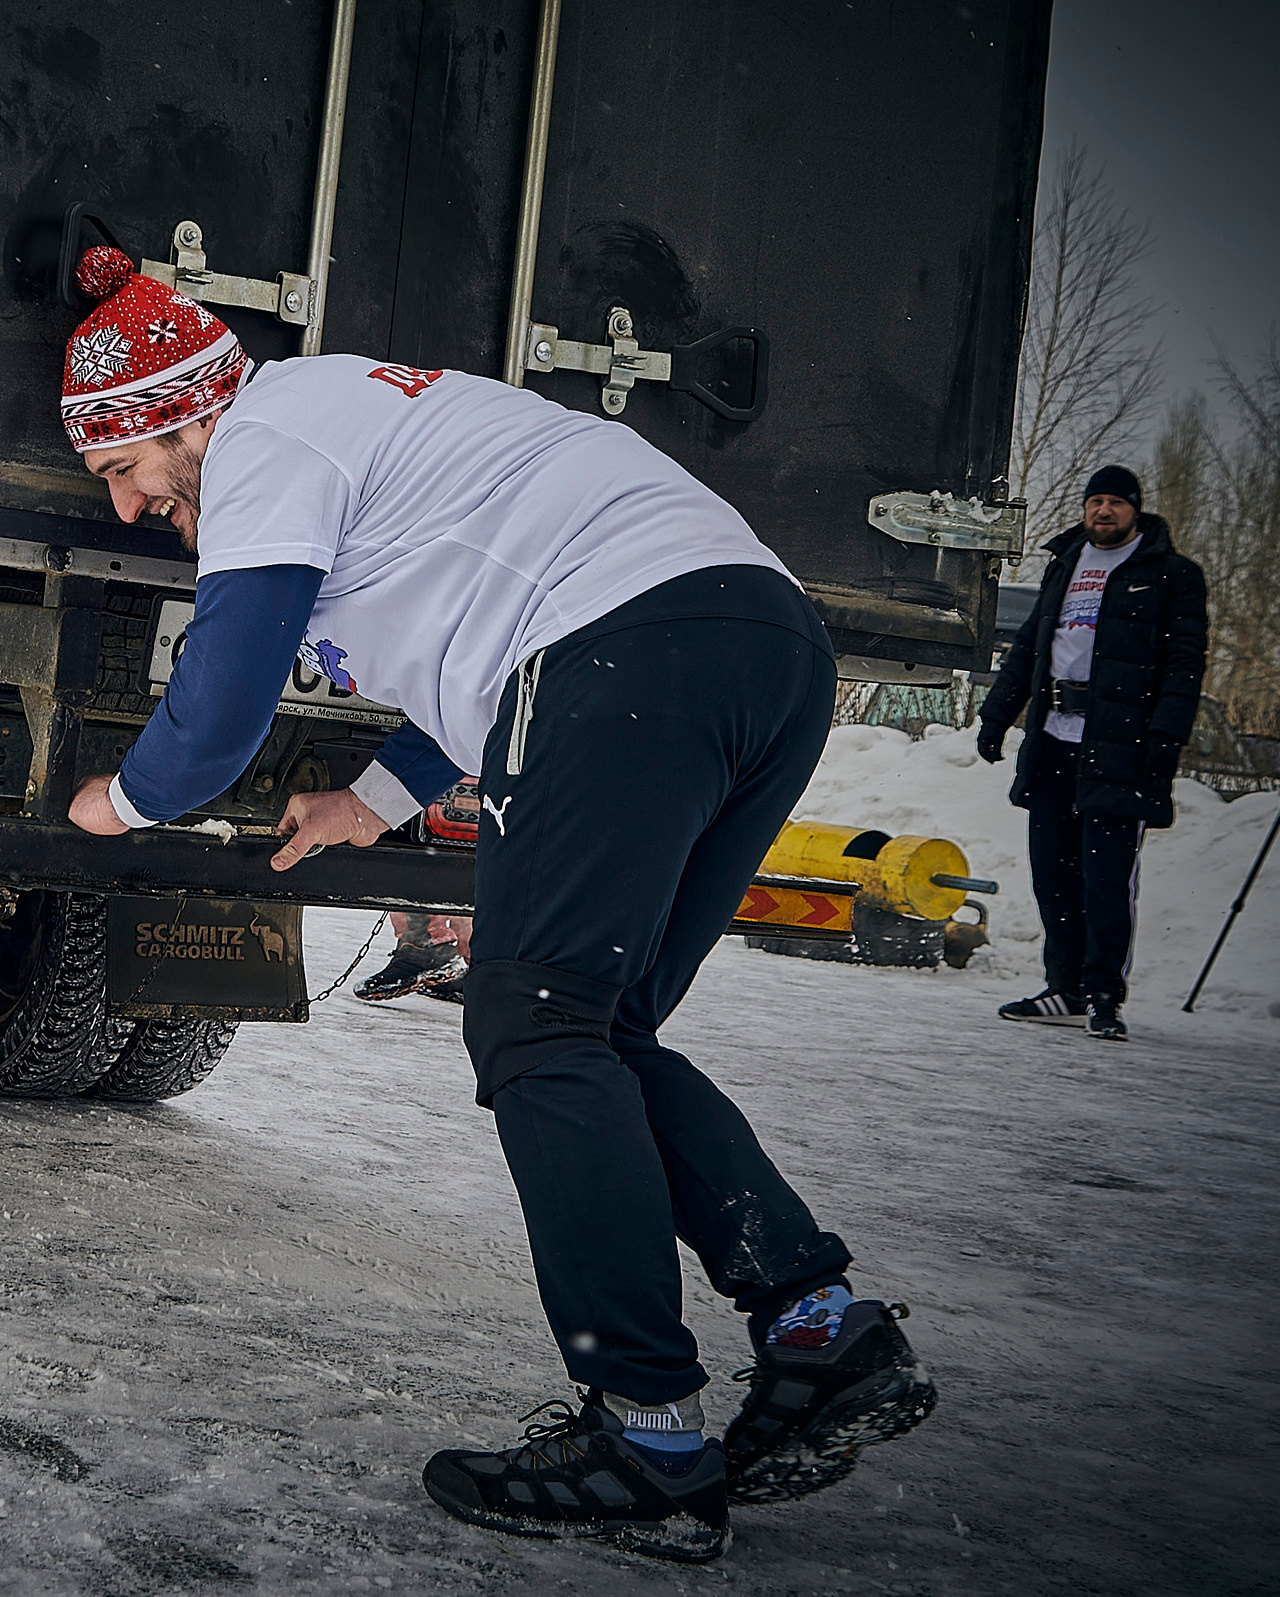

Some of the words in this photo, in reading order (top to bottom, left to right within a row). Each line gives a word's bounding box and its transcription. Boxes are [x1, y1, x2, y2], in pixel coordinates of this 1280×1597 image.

[276, 704, 301, 715] ярск,
[303, 707, 316, 715] ул.
[368, 714, 382, 724] 50,
[135, 922, 246, 944] SCHMITZ
[135, 943, 246, 961] CARGOBULL
[627, 1410, 672, 1430] PUMA
